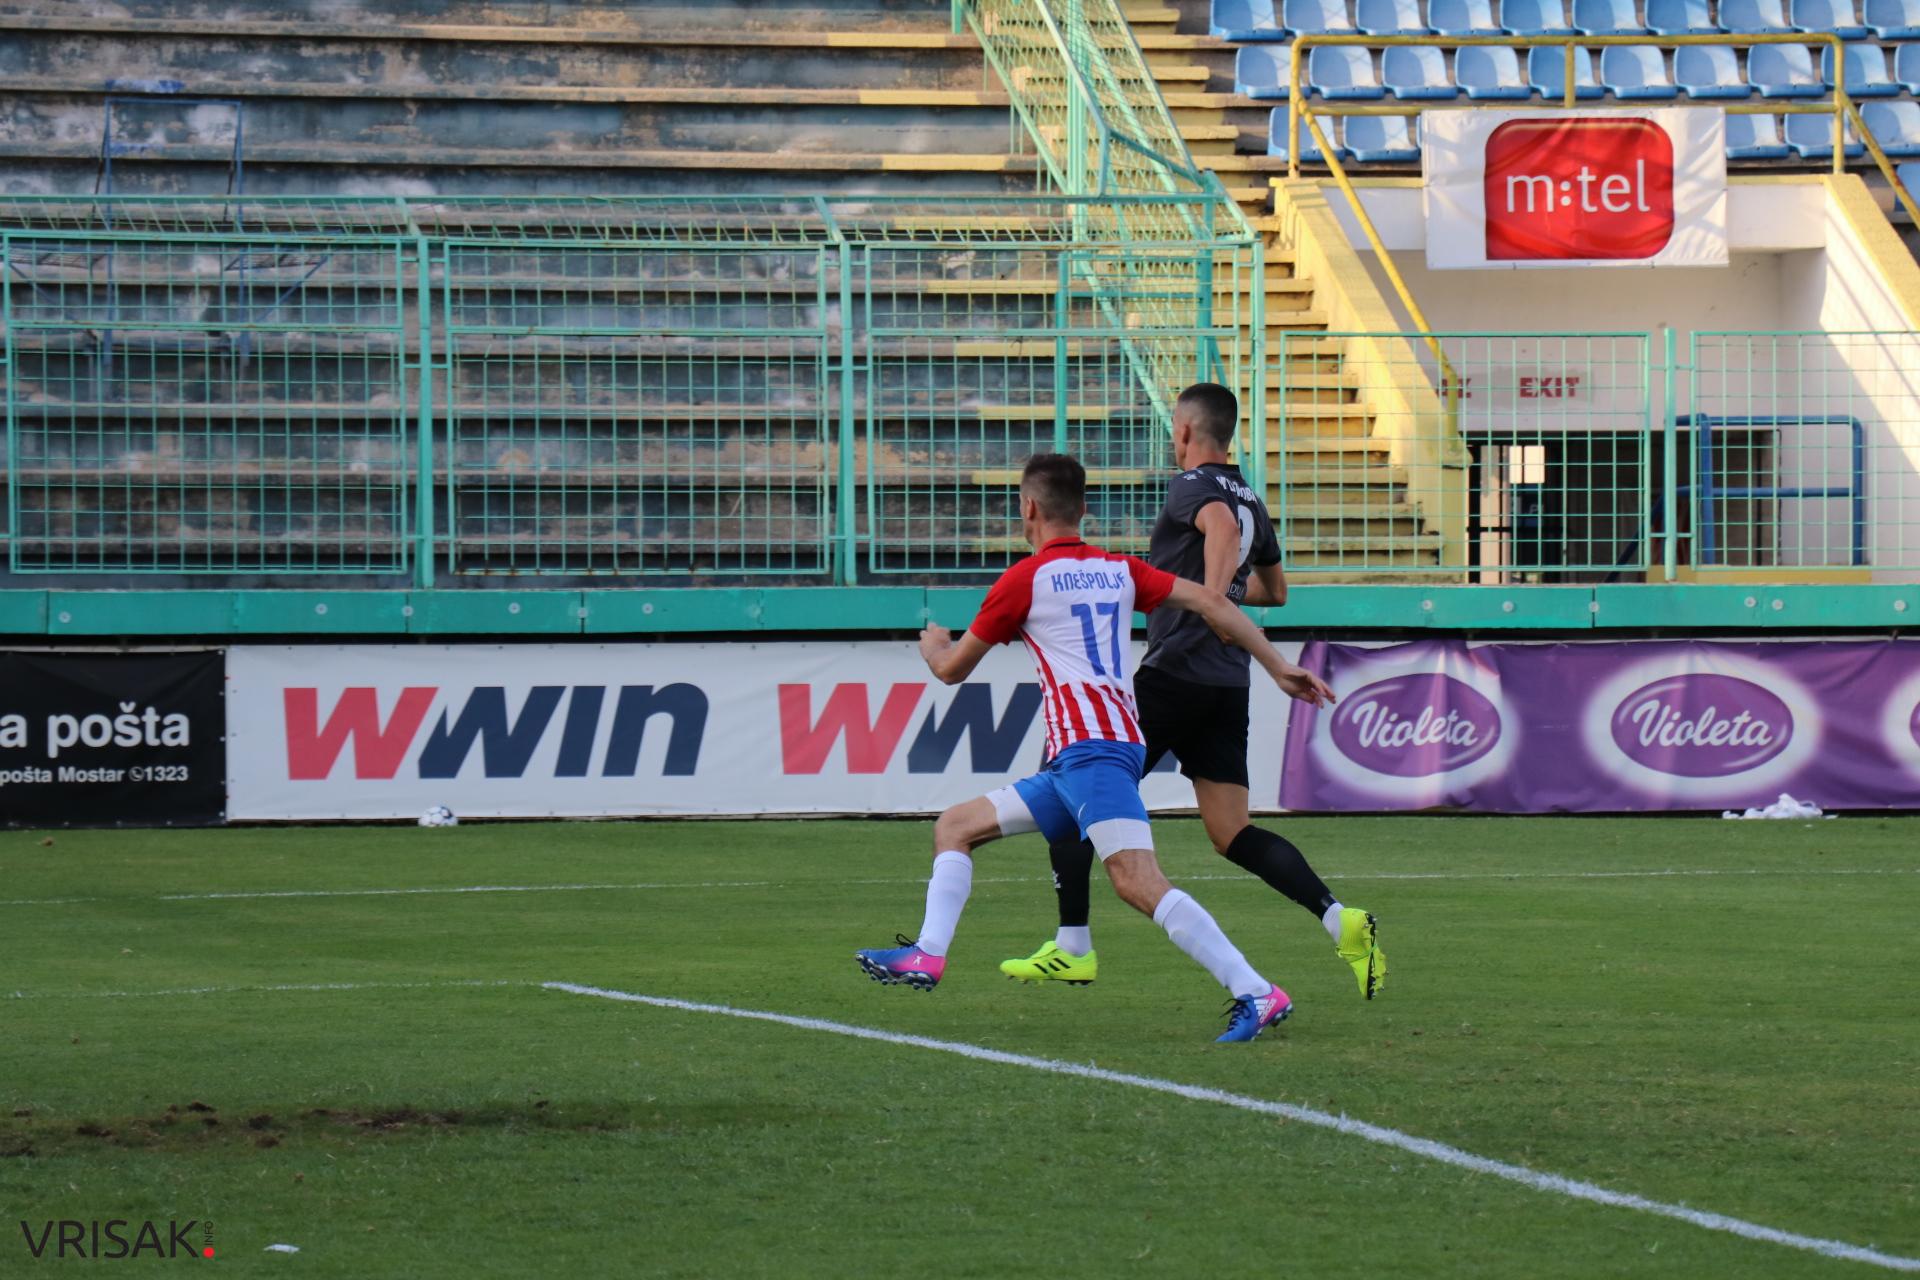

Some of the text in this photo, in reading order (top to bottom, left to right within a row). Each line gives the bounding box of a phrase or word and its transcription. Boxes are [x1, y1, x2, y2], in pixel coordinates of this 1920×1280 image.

[1506, 159, 1650, 213] m:tel
[1519, 376, 1580, 398] EXIT
[1070, 601, 1122, 679] 17
[47, 701, 190, 759] pošta
[1352, 699, 1480, 749] Violeta
[1632, 699, 1773, 748] Violeta
[58, 766, 125, 782] Mostar
[145, 766, 189, 782] 1323
